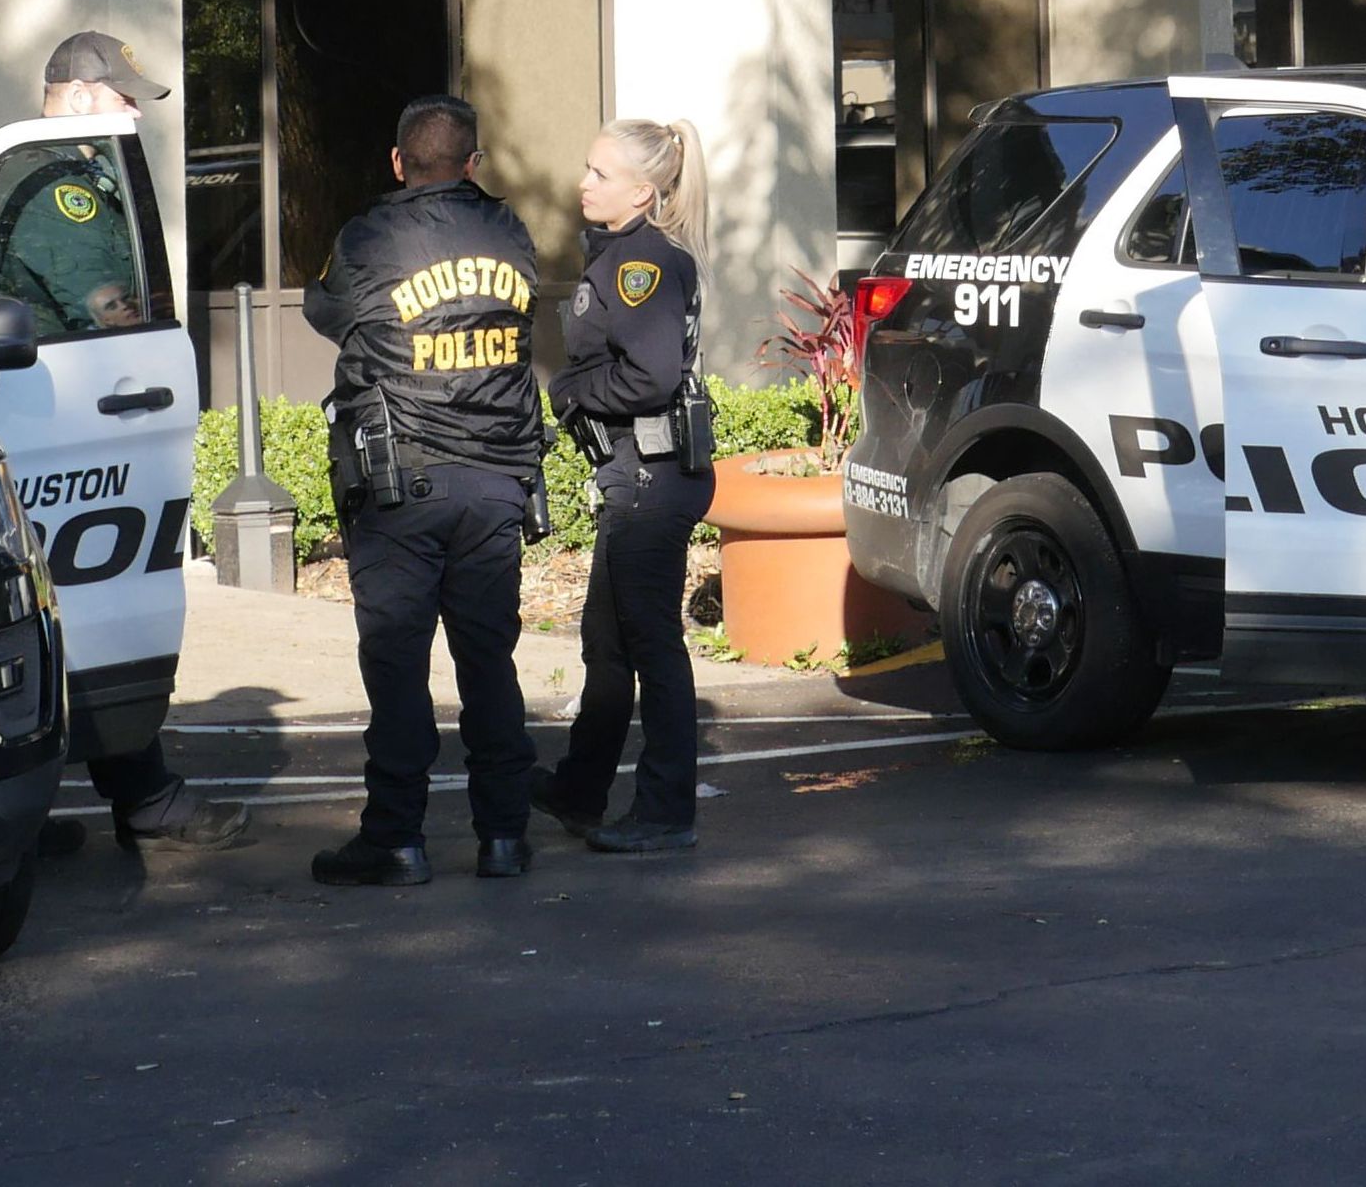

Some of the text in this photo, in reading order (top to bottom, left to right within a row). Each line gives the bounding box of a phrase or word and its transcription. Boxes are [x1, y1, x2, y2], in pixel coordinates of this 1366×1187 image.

[391, 256, 531, 324] HOUSTON
[904, 254, 1070, 284] EMERGENCY
[954, 283, 1021, 327] 911
[413, 326, 519, 371] POLICE
[13, 463, 130, 510] USTON
[851, 462, 908, 495] EMERGENCY
